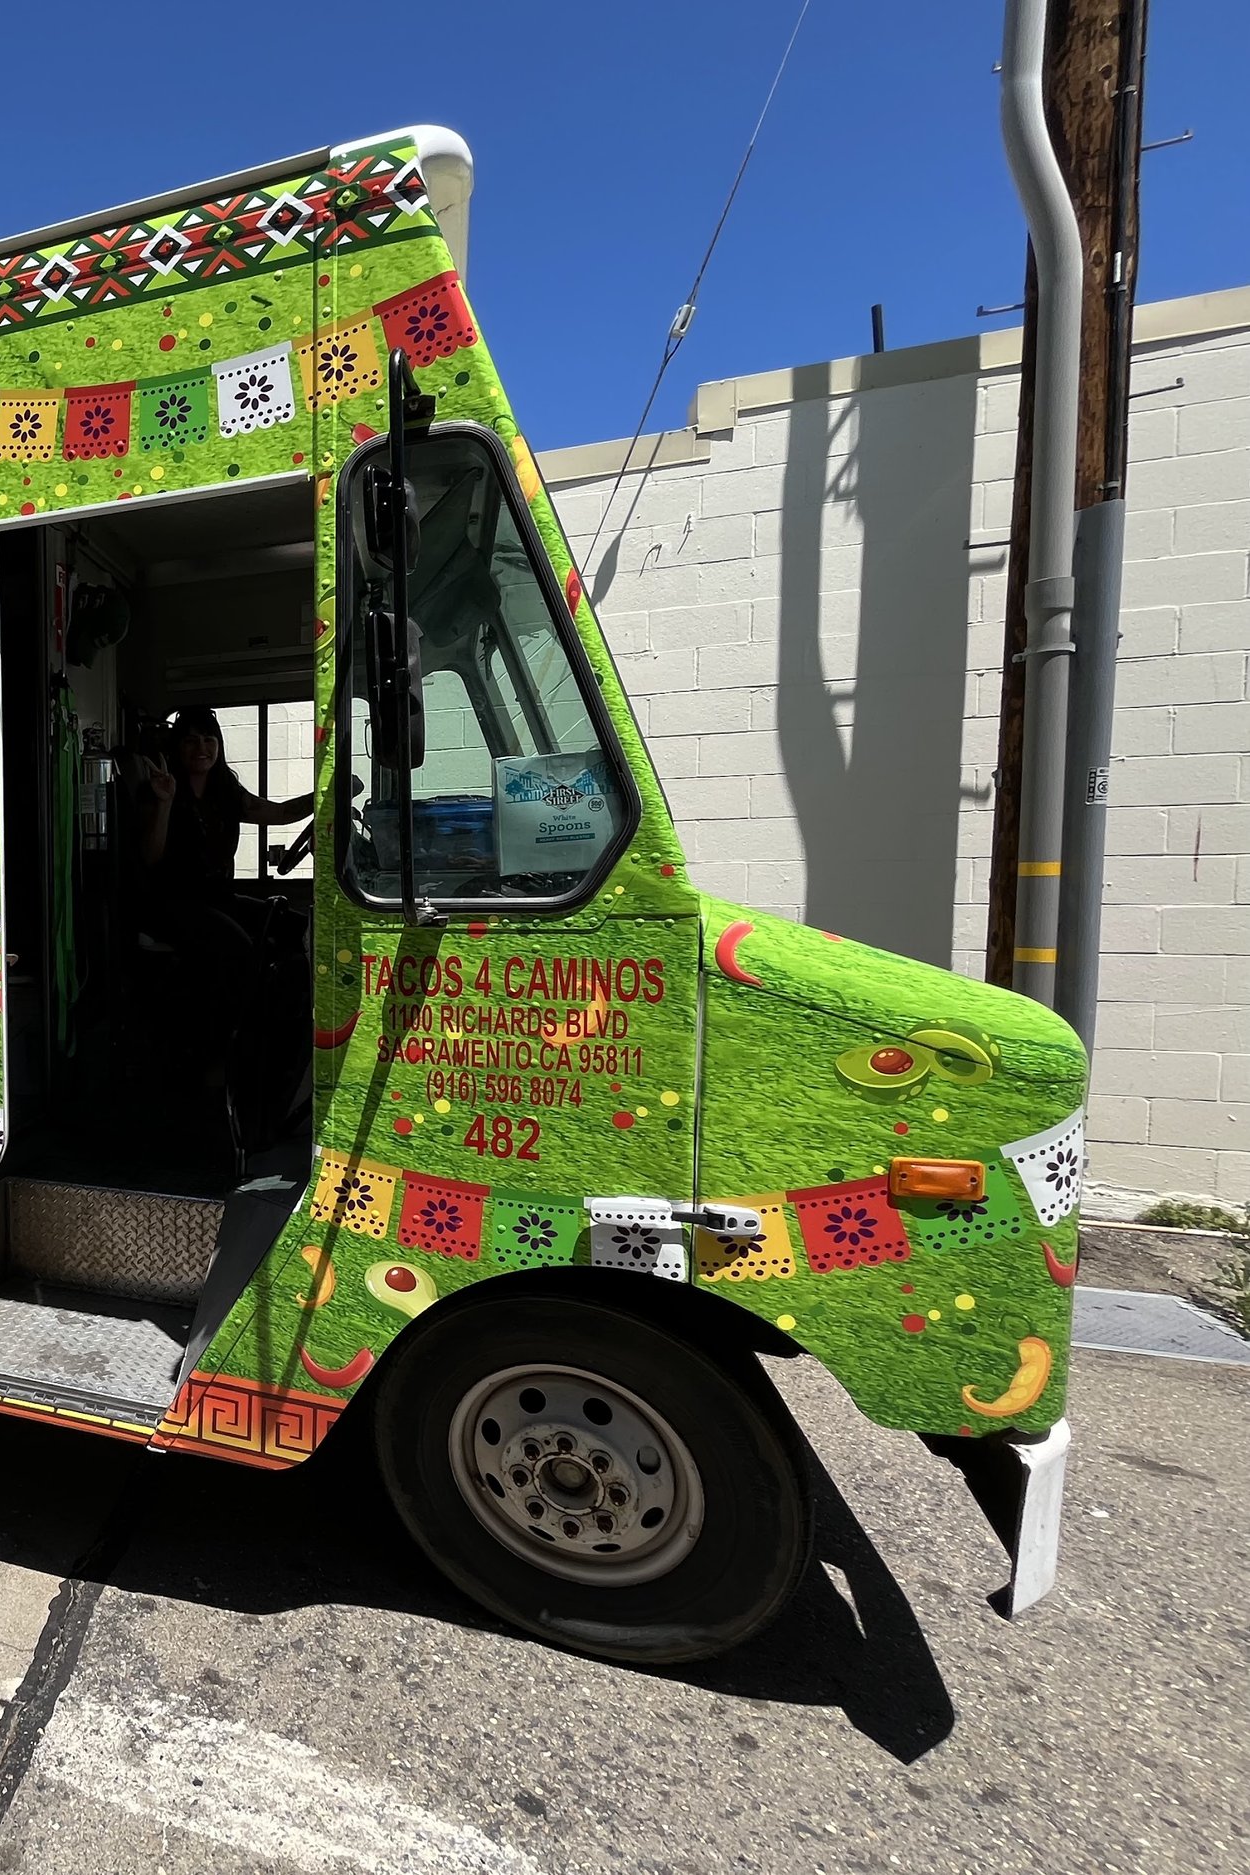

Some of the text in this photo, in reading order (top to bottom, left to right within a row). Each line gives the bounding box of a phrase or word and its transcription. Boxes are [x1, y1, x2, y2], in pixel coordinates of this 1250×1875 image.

[546, 795, 581, 806] STREET
[550, 788, 576, 797] FIRST
[539, 821, 591, 834] Spoons
[360, 955, 665, 1004] TACOS 4 CAMINOS
[389, 1003, 629, 1039] 1100 RICHARDS BLVD
[378, 1035, 643, 1077] SACRAMENTO CA 95811
[427, 1070, 582, 1108] (916) 596 8074
[463, 1114, 541, 1161] 482
